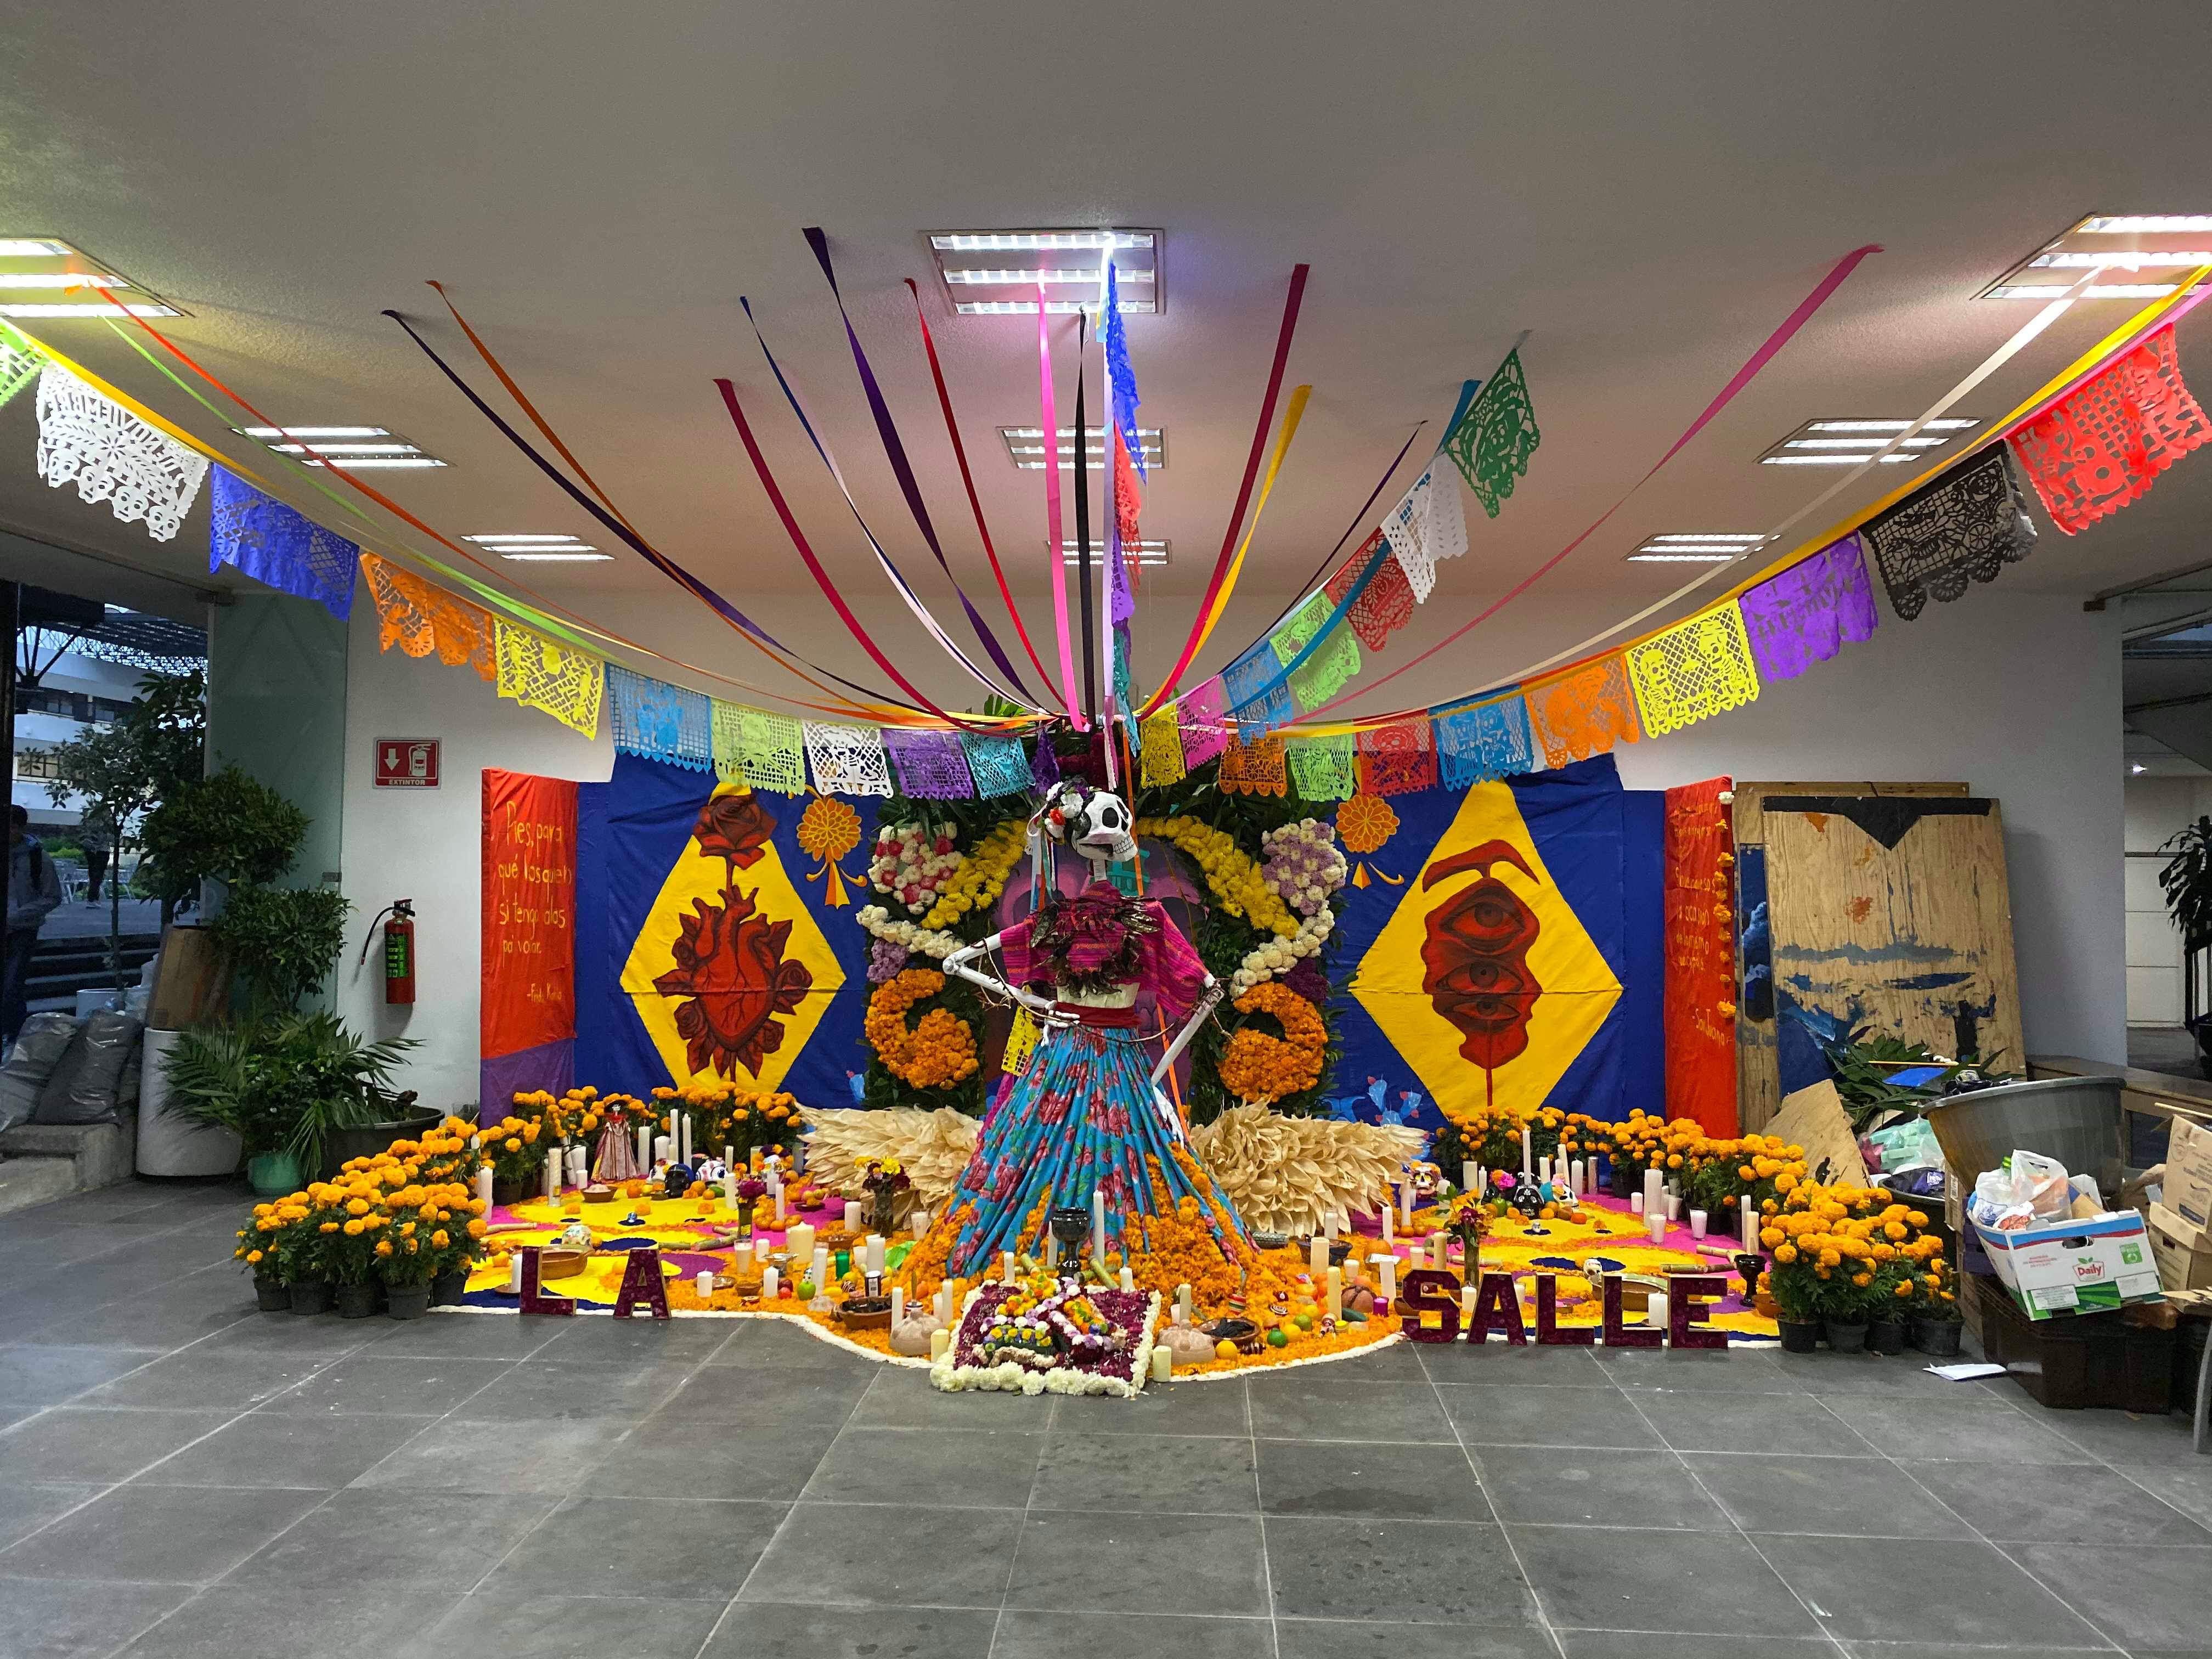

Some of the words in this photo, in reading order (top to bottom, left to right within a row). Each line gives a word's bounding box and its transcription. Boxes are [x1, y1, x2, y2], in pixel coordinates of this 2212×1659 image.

[536, 823, 562, 857] para
[499, 853, 518, 895] qué
[524, 851, 541, 883] los
[545, 895, 566, 928] alas
[517, 940, 541, 953] voar.
[2078, 1263, 2102, 1276] Daily
[520, 1246, 672, 1320] LA
[1402, 1269, 1728, 1349] SALLE
